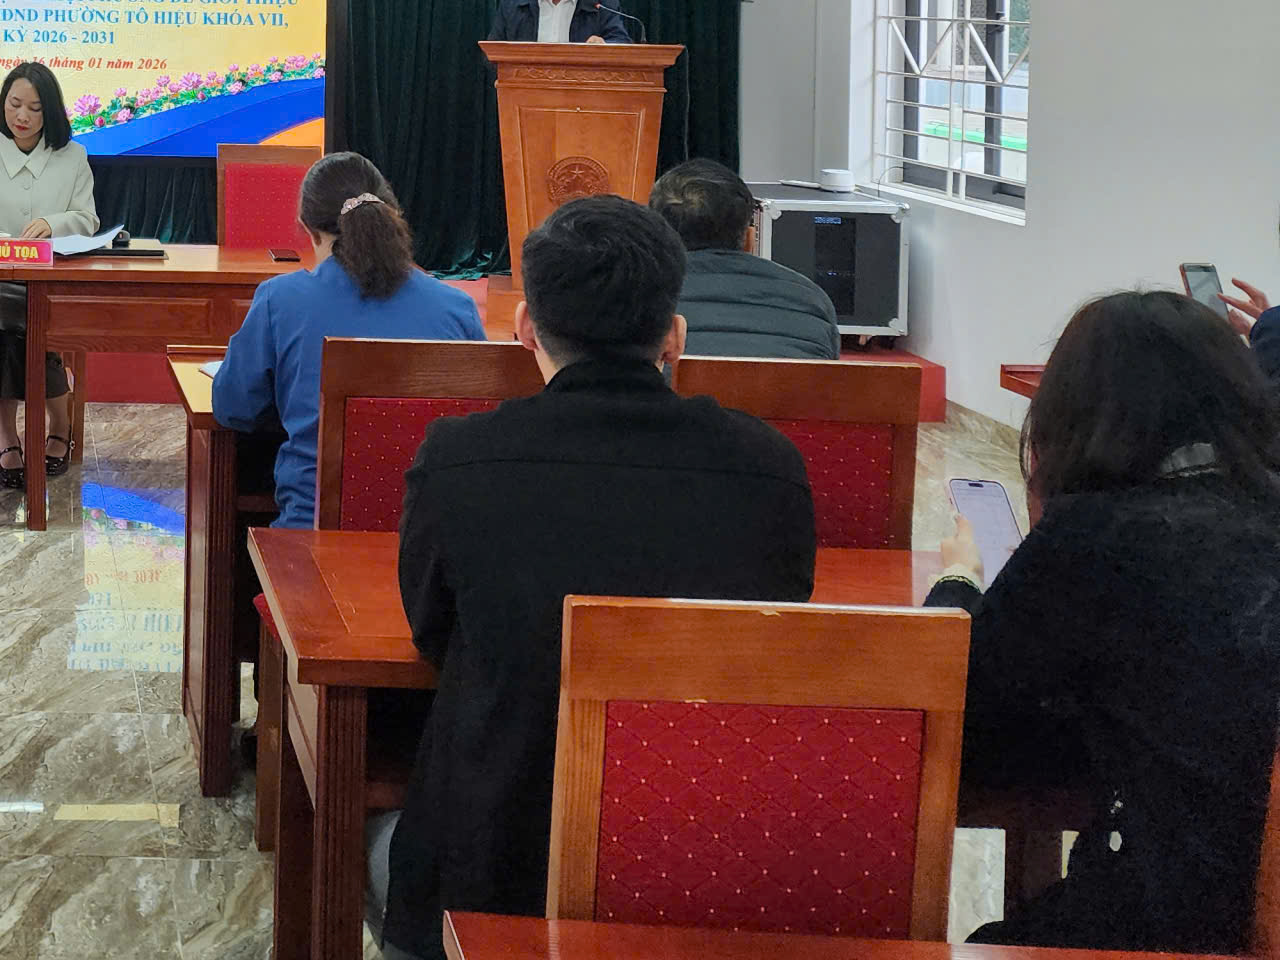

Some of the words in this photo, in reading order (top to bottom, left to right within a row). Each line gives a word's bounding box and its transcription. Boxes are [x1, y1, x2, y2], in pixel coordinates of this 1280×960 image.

[44, 6, 120, 23] PHƯỜNG
[124, 7, 149, 24] TÔ
[153, 10, 197, 28] HIỆU
[202, 9, 254, 26] KHÓA
[258, 13, 289, 29] VII,
[3, 25, 28, 43] KỲ
[33, 30, 68, 43] 2026
[81, 31, 115, 44] 2031
[49, 56, 84, 71] tháng
[88, 57, 103, 69] 01
[106, 58, 134, 69] năm
[137, 58, 167, 70] 2026
[14, 246, 39, 261] TỌA
